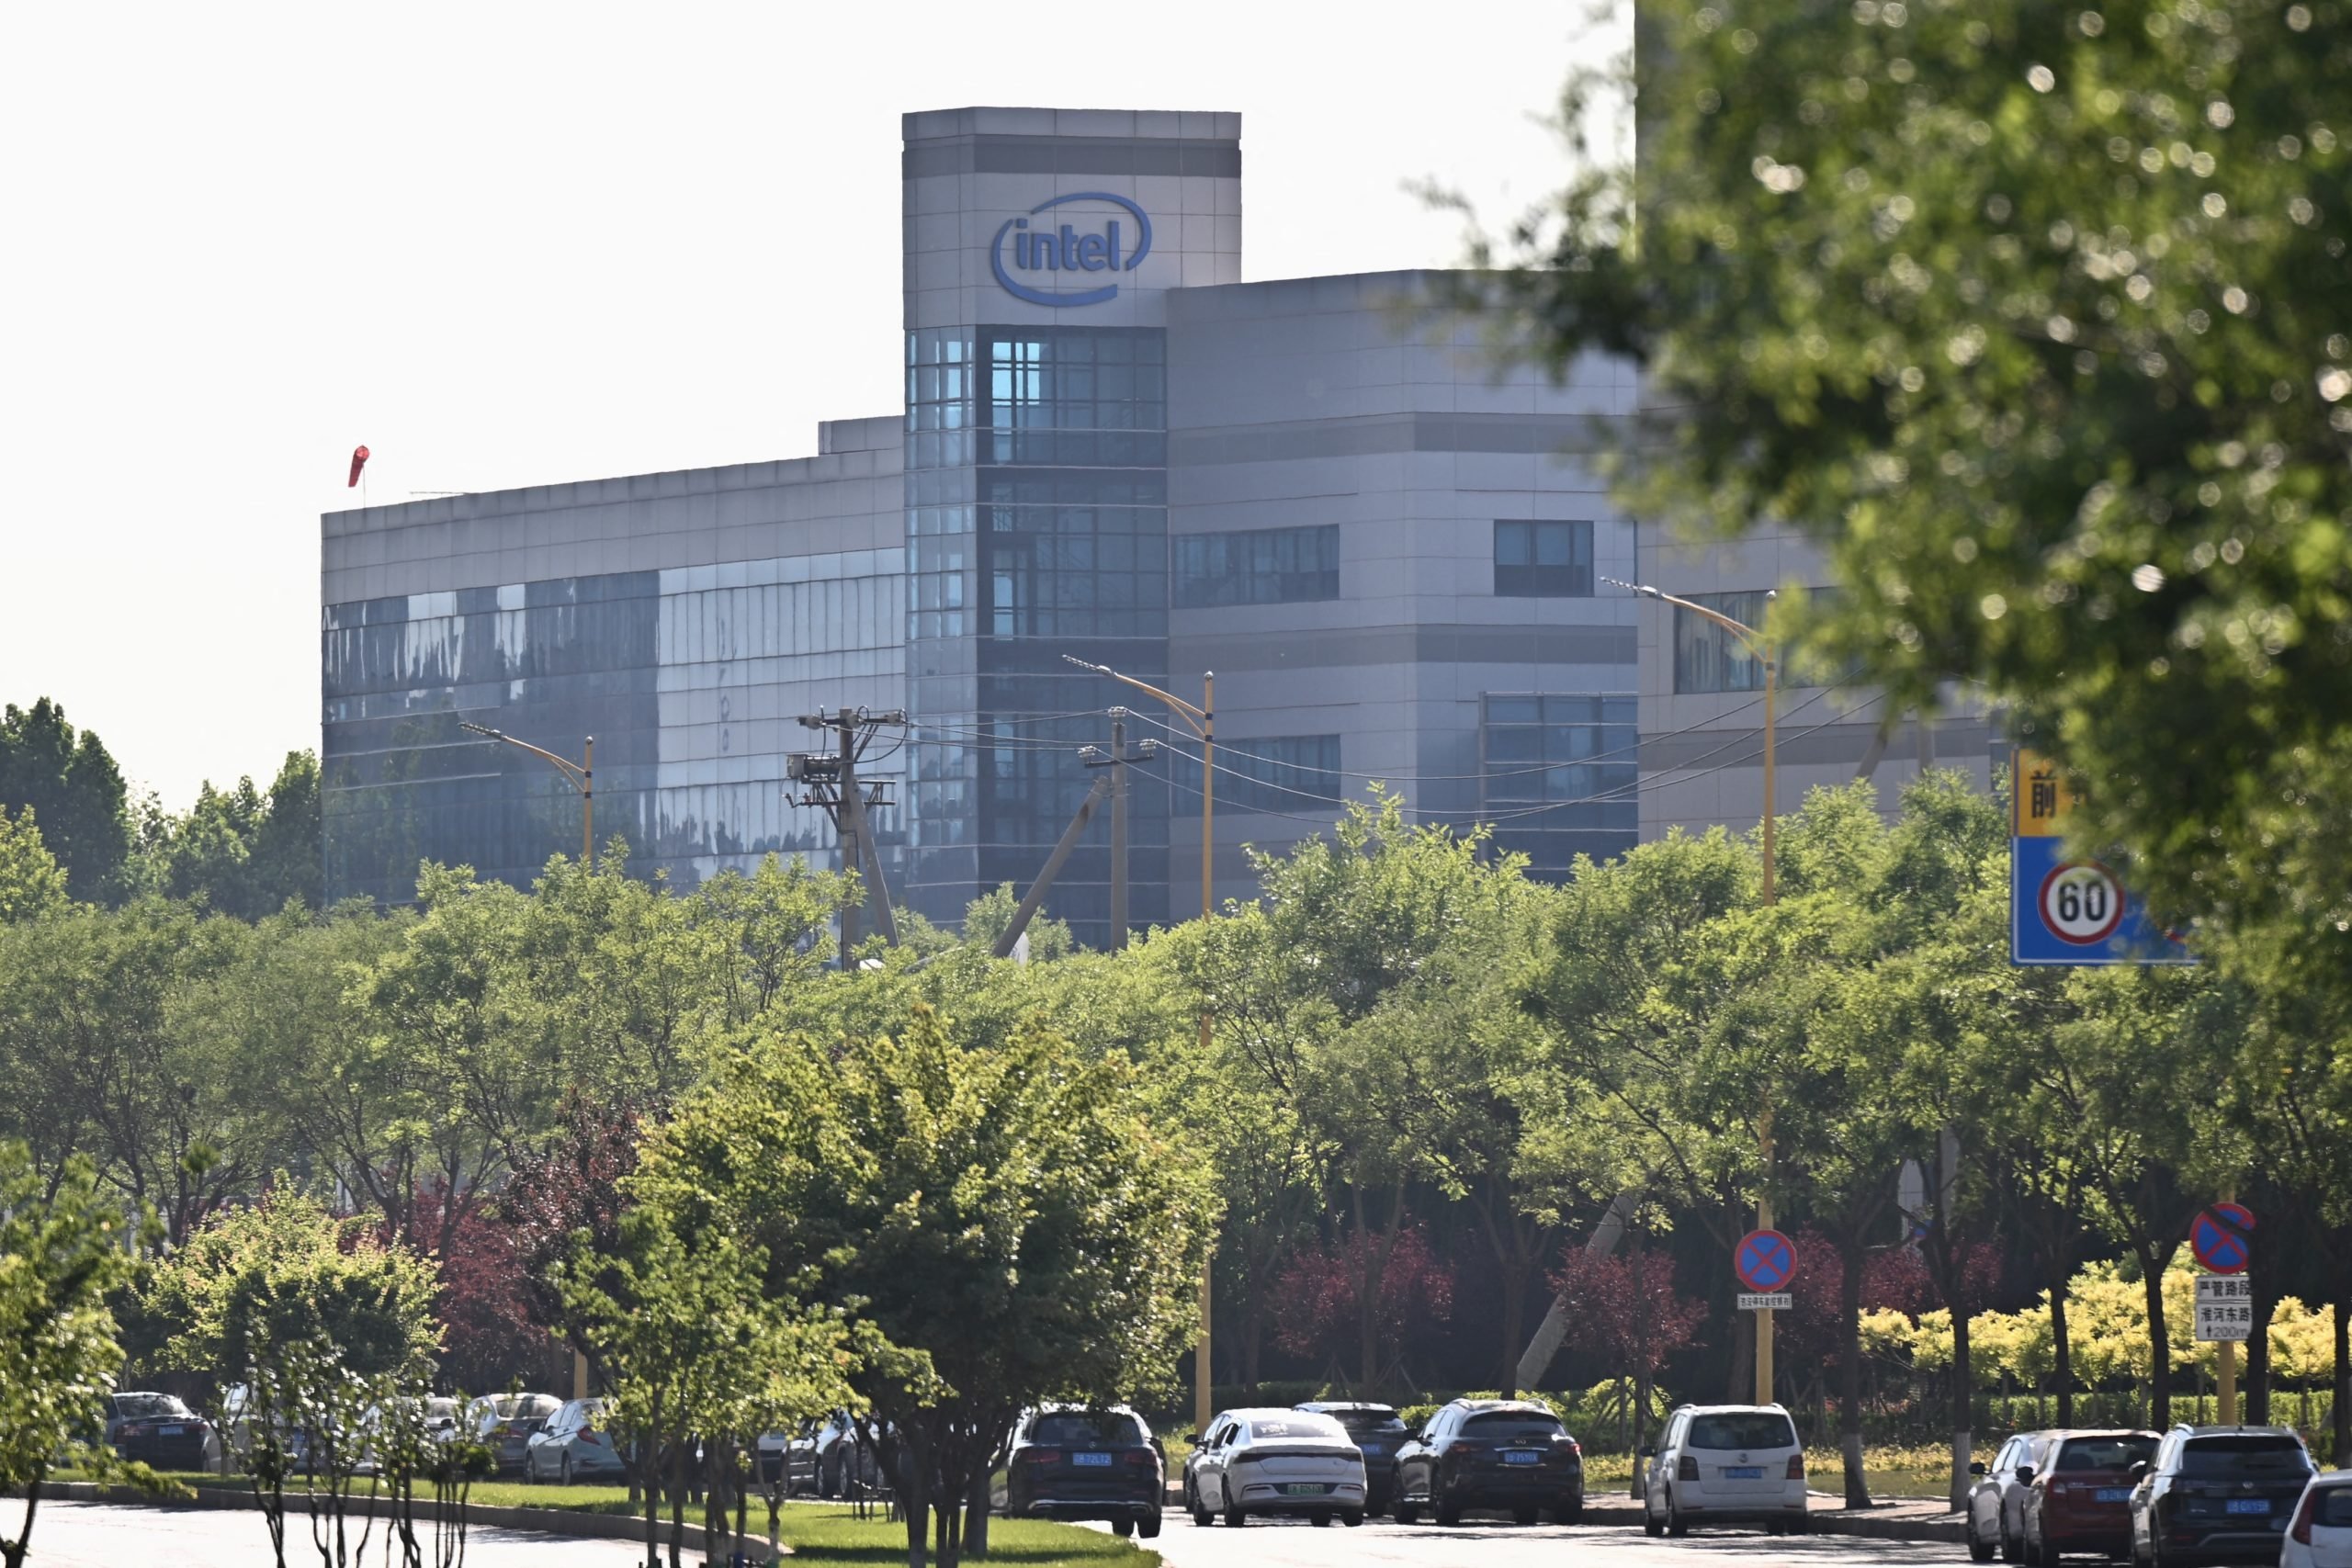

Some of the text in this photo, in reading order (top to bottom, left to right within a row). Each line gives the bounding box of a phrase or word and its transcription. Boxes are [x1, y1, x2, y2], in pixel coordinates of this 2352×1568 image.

[1016, 218, 1120, 272] intel
[2058, 880, 2106, 922] 60
[2199, 1280, 2250, 1296] 严管路段
[2200, 1307, 2250, 1322] 淮河东路
